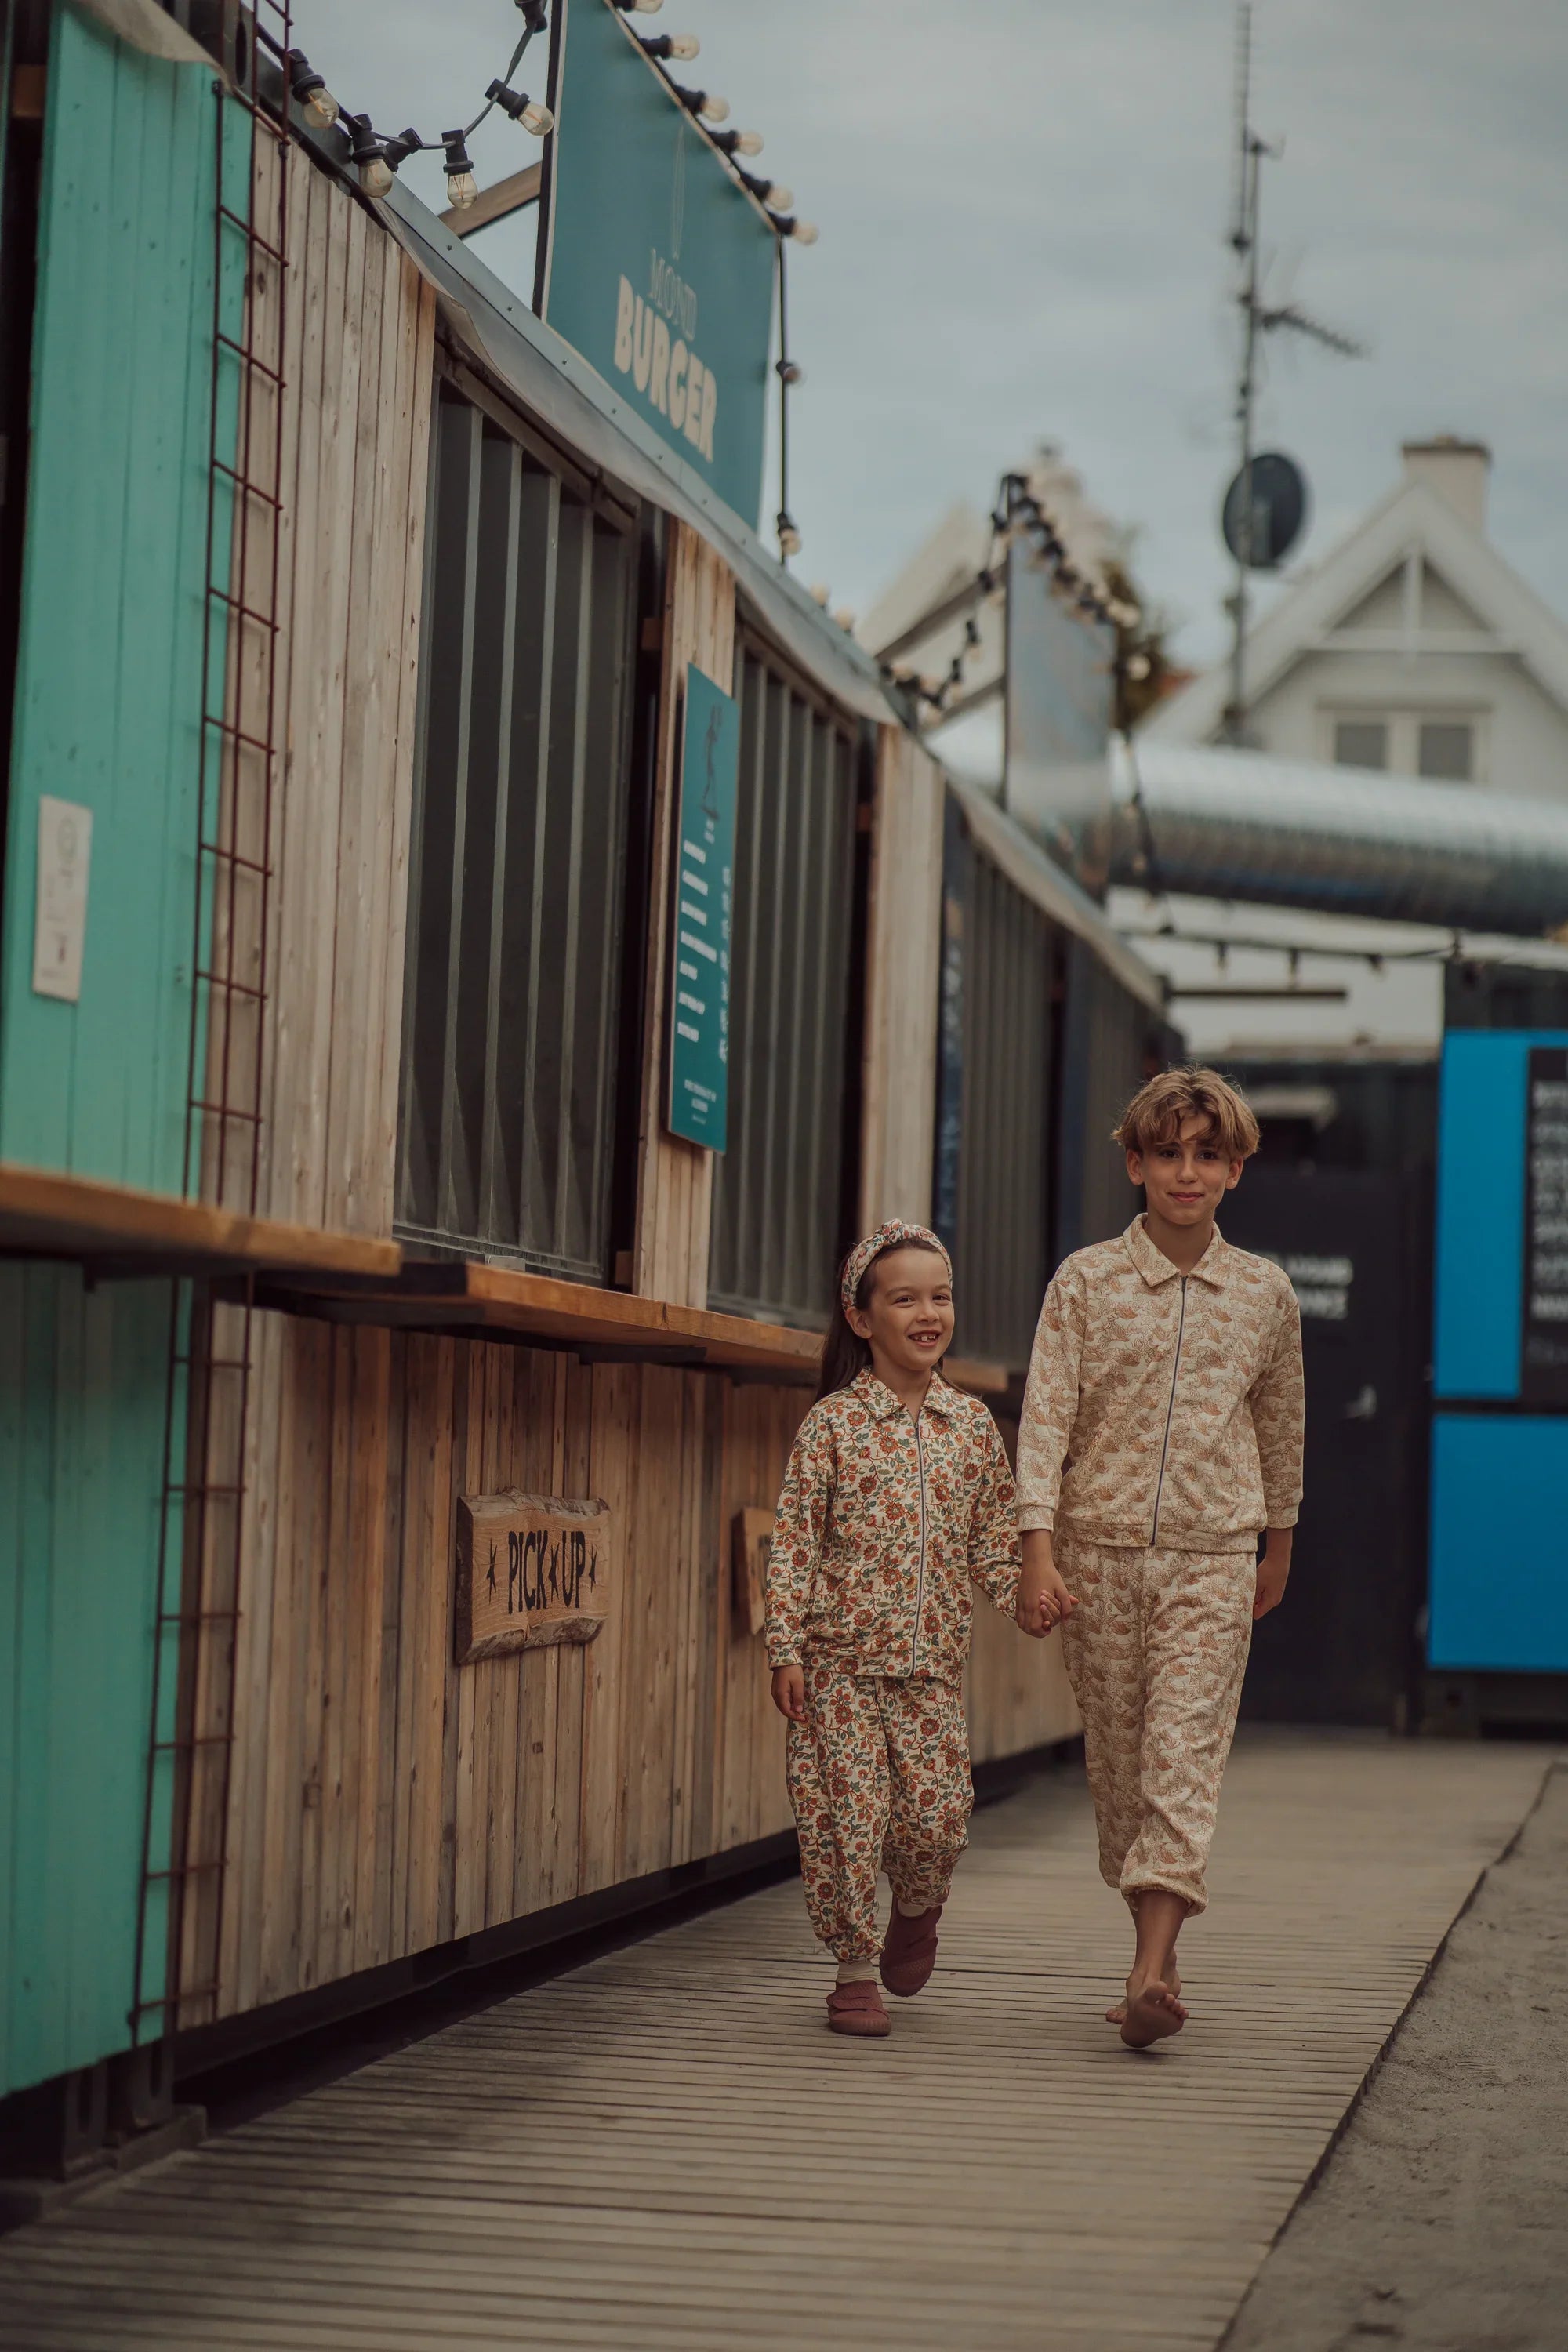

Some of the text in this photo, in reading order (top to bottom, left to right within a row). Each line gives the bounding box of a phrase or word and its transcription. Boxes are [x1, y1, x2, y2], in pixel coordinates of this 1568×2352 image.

[614, 274, 717, 463] BURGER
[508, 1530, 586, 1614] PICK UP
